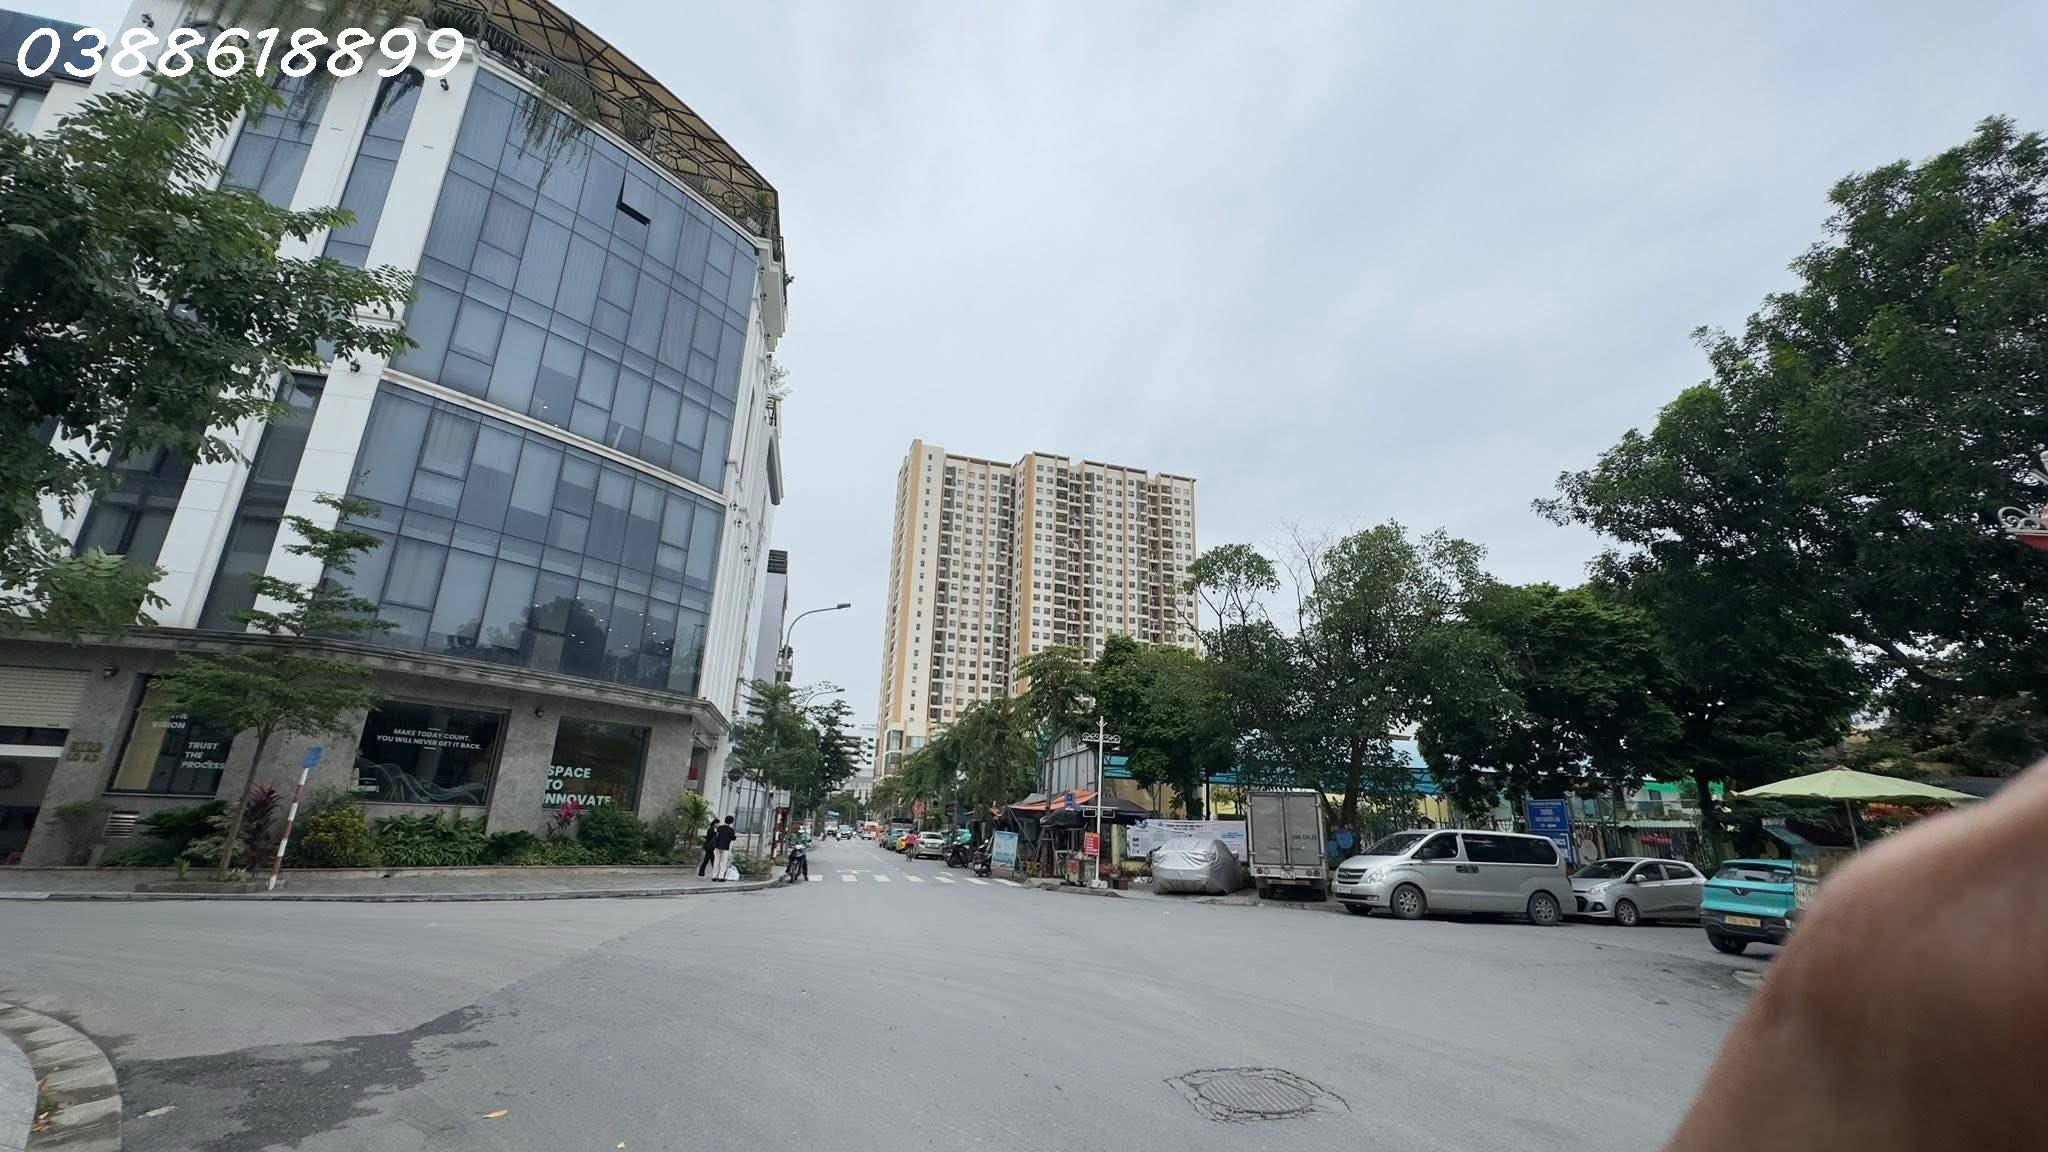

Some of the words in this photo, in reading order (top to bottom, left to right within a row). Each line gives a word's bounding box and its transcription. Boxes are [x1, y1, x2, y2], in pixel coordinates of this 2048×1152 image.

[376, 734, 394, 742] YOU
[395, 736, 412, 744] WILL
[413, 738, 438, 746] NEVER
[438, 740, 452, 748] GET
[393, 728, 416, 736] MAKE
[417, 730, 442, 738] TODAY
[443, 733, 471, 742] COUNT.
[187, 741, 219, 750] TRUST
[184, 751, 204, 759] THE
[180, 761, 226, 770] PROCESS
[547, 765, 592, 779] SPACE
[545, 778, 563, 790] TO
